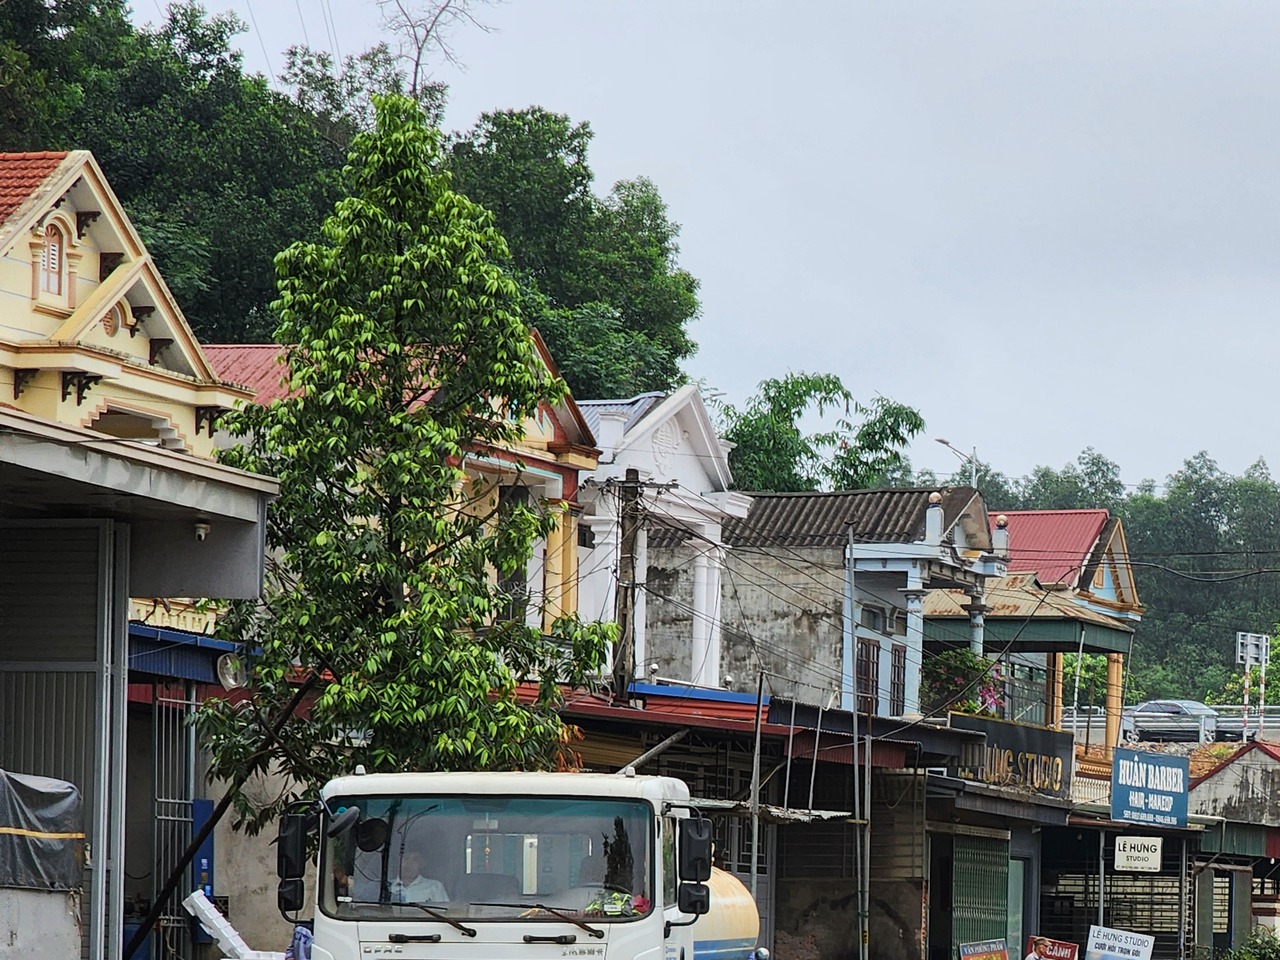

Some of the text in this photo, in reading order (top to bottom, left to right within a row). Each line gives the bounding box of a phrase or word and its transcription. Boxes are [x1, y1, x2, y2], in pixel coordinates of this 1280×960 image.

[1018, 752, 1063, 791] STUDIO
[1118, 754, 1184, 794] HUÂN BARBER
[1118, 840, 1157, 853] LÊ HƯNG
[1092, 929, 1149, 948] LÊ HƯNG STUDIO
